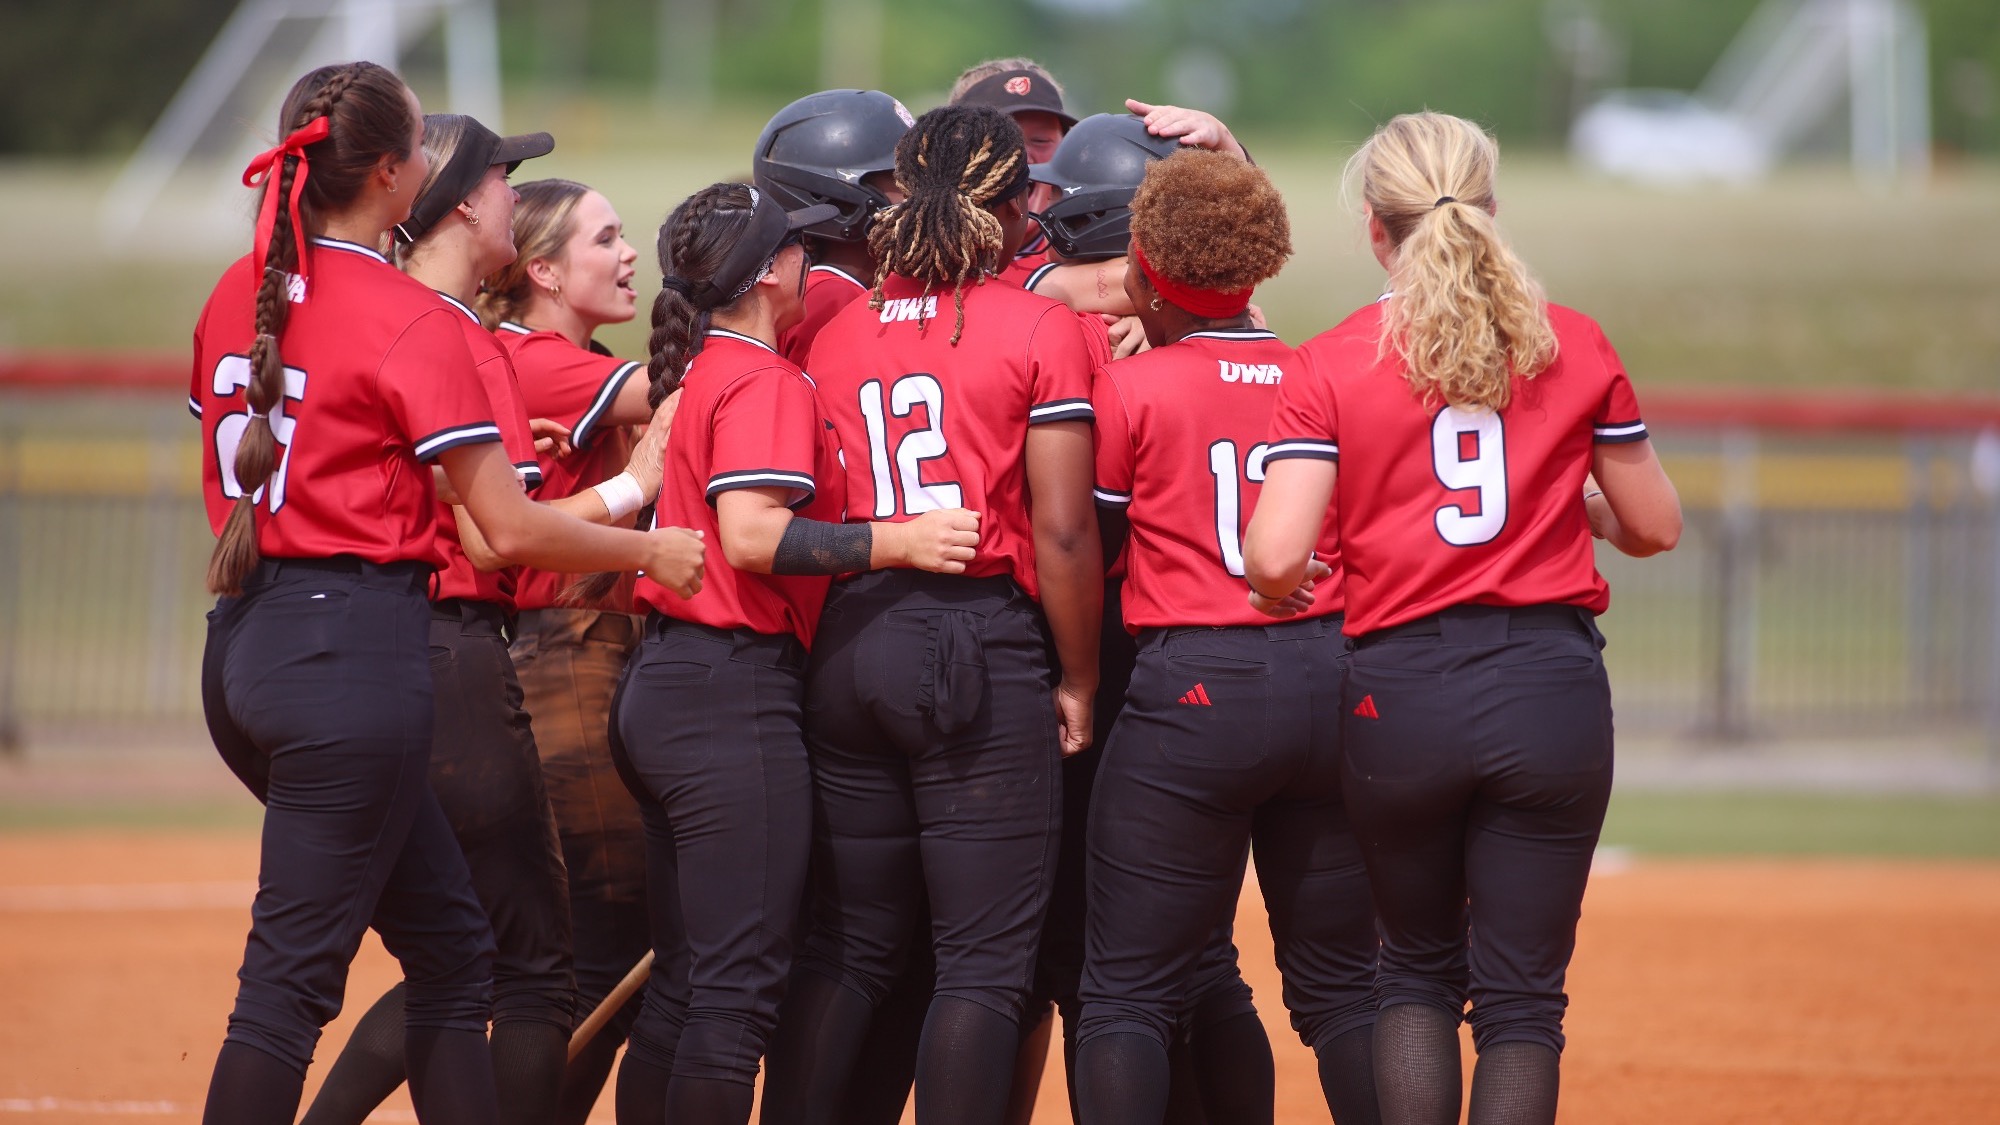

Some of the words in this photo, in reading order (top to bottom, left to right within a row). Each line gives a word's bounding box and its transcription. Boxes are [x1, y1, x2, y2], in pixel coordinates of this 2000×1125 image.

[879, 295, 938, 323] UWA
[1217, 359, 1283, 385] UWA
[858, 372, 964, 520] 12
[1430, 403, 1509, 548] 9
